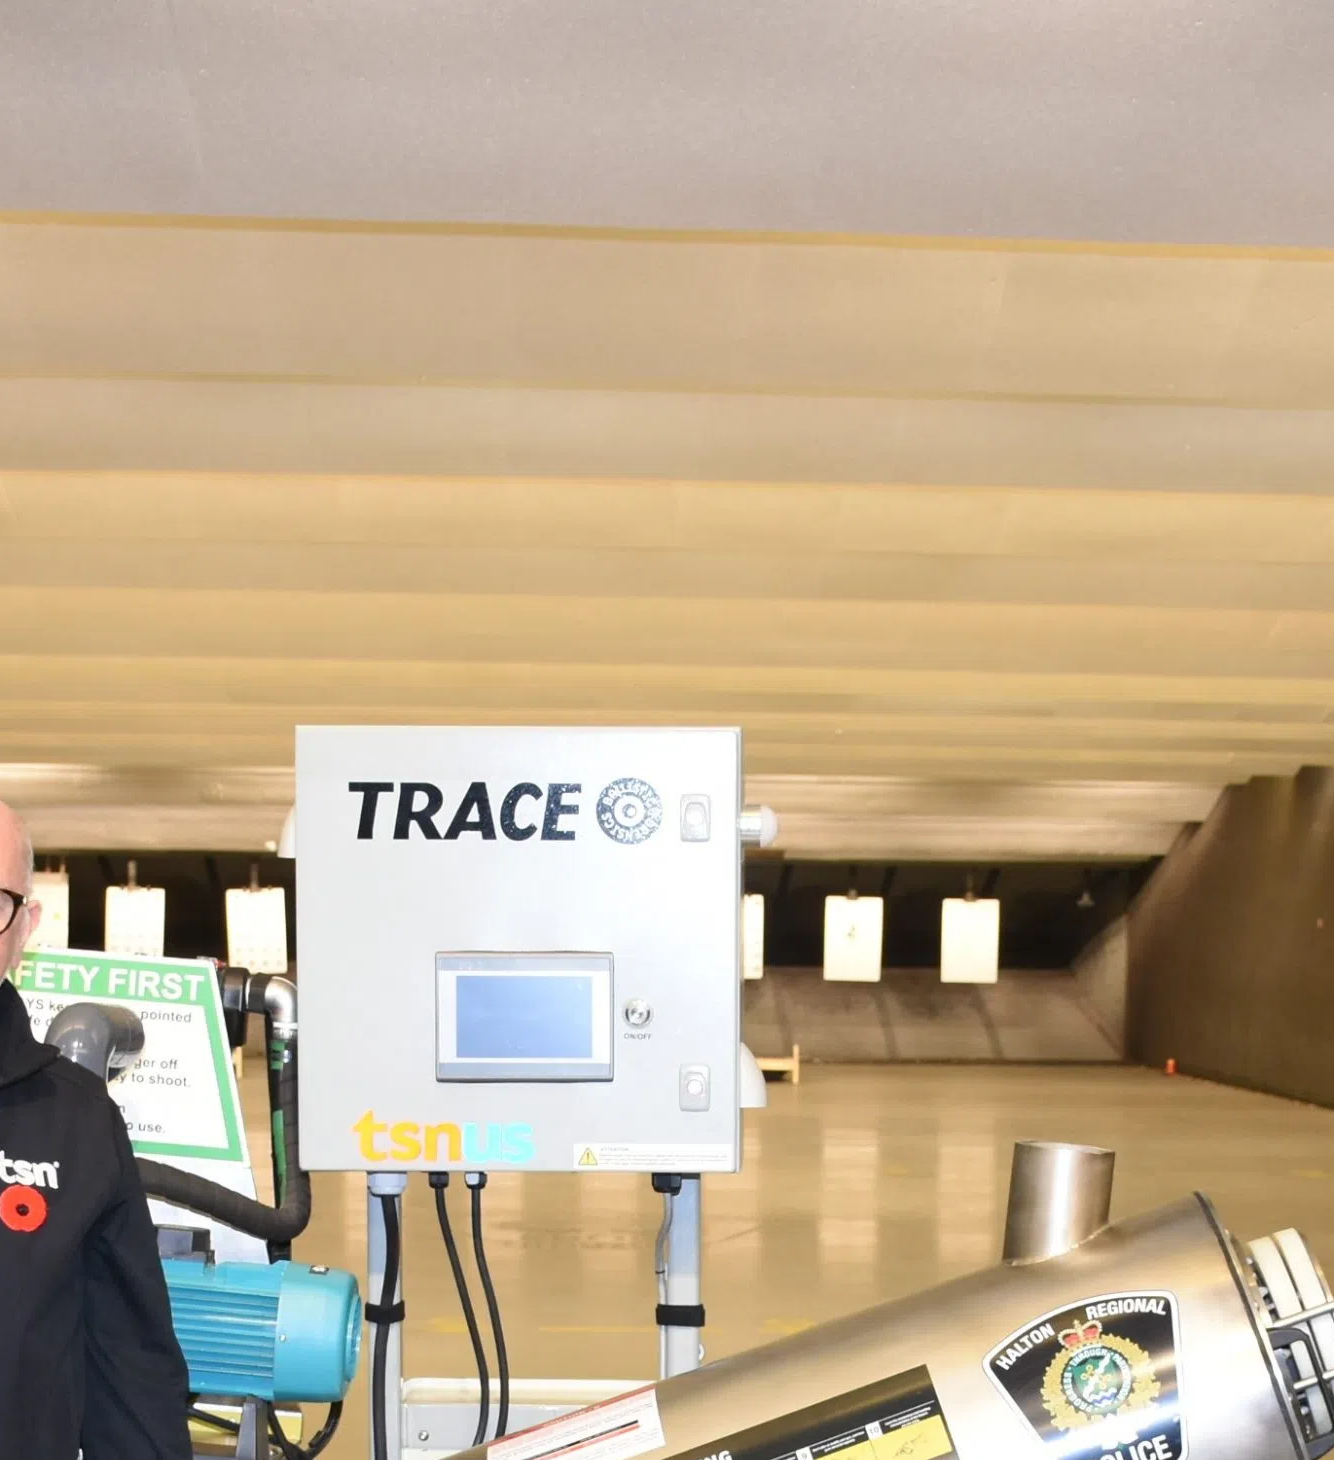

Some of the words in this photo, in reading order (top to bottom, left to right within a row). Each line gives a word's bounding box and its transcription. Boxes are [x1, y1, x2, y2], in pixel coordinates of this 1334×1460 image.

[348, 781, 582, 841] TRACE
[14, 960, 100, 992] FETY
[108, 968, 205, 1001] FIRST
[141, 1011, 192, 1023] pointed
[160, 1059, 178, 1069] off
[131, 1073, 144, 1083] to
[149, 1074, 191, 1088] shoot.
[138, 1123, 166, 1133] use.
[353, 1108, 534, 1163] tsnus
[996, 1323, 1055, 1370] HALTON
[1086, 1298, 1167, 1320] REGIONAL
